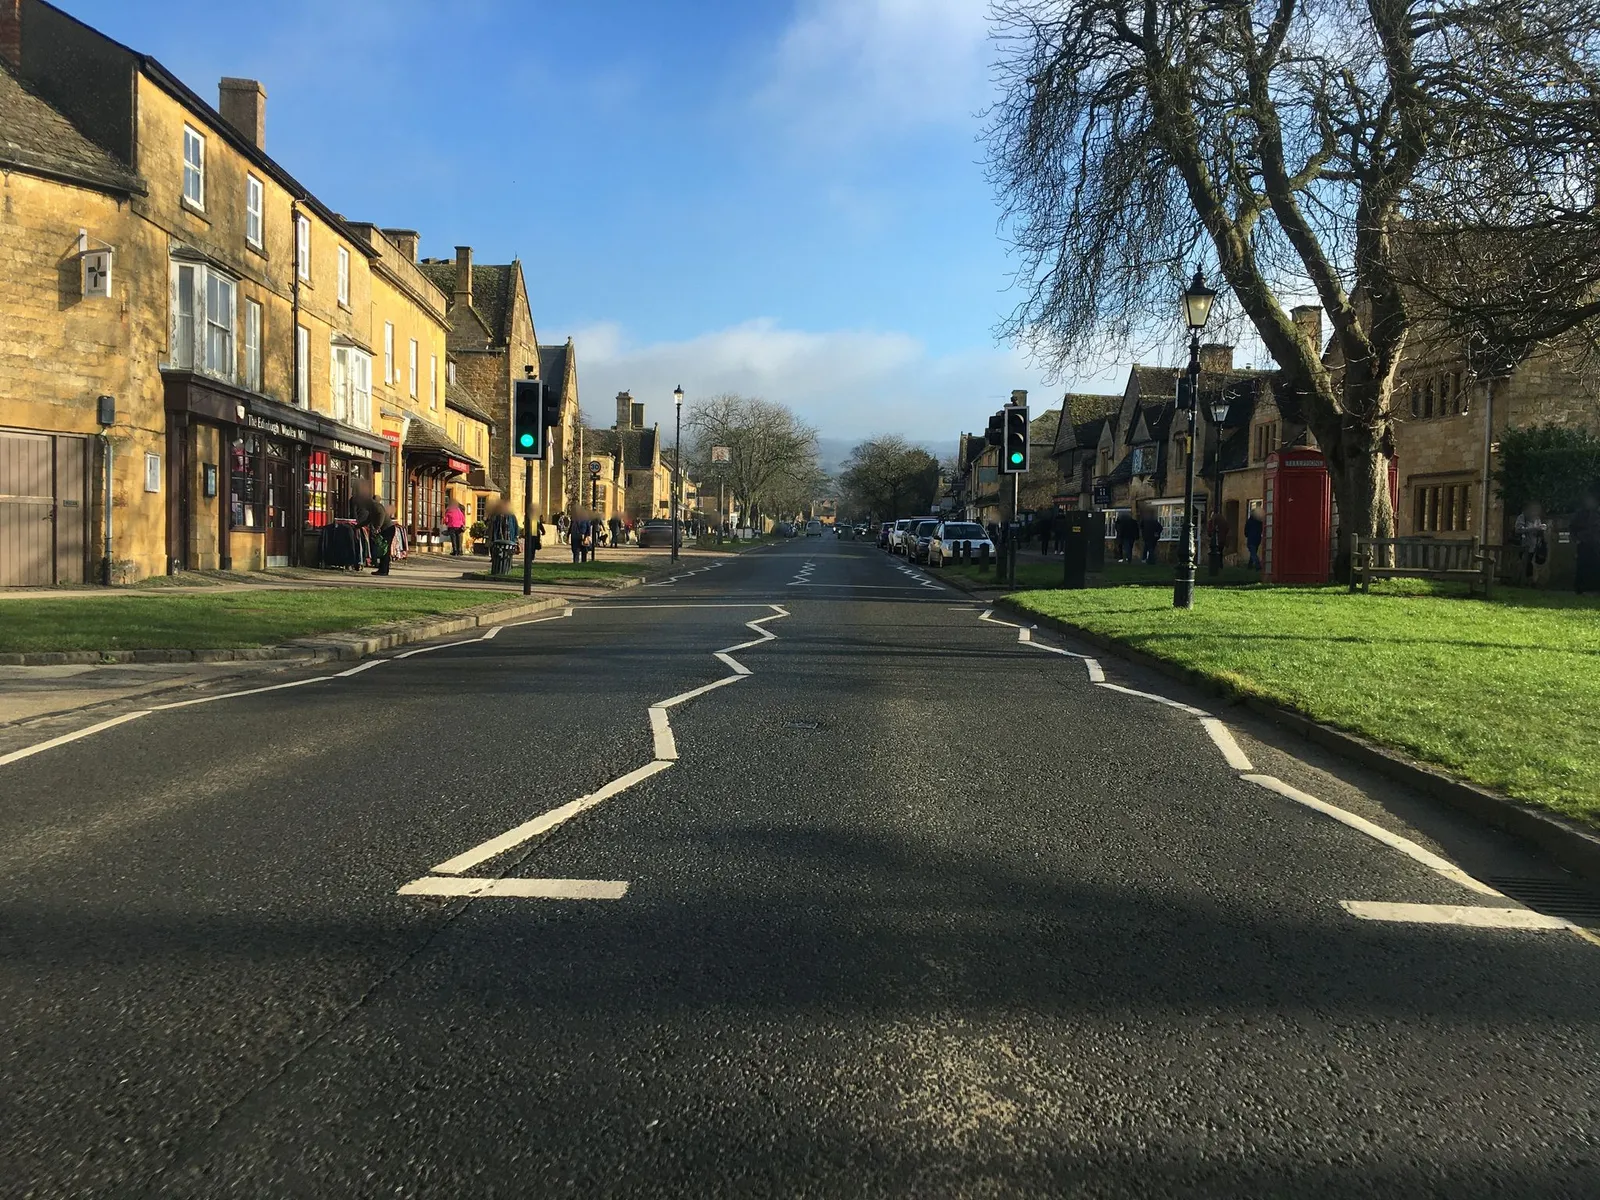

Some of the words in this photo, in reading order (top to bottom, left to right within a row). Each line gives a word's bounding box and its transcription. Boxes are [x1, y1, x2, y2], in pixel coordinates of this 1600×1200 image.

[248, 414, 257, 427] The
[258, 416, 279, 435] Edinburgh
[281, 423, 297, 438] Woollen
[298, 429, 307, 441] Mill
